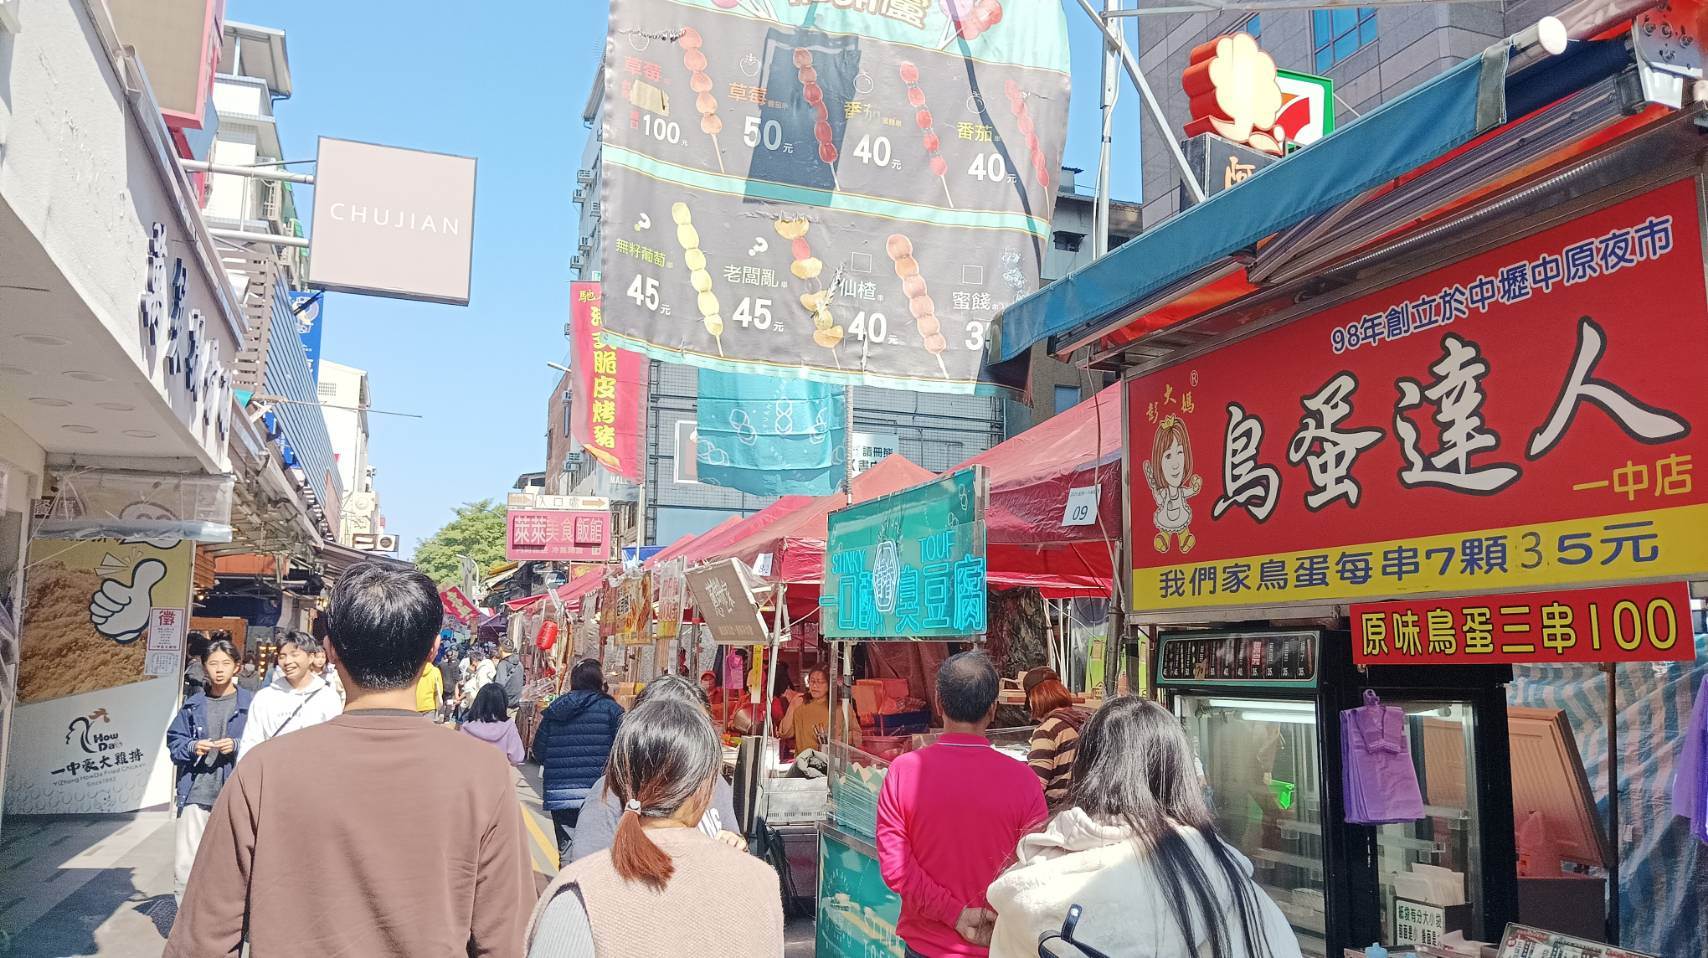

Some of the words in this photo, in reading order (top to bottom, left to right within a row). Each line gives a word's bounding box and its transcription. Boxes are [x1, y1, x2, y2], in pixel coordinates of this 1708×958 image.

[728, 81, 767, 106] 草莓
[956, 121, 993, 143] 番茄
[330, 202, 459, 236] CHUJIAN
[578, 289, 602, 303] 馳
[1331, 215, 1675, 355] 98年創立於中壢中原夜市
[1211, 316, 1692, 524] 鳥蛋達人
[1572, 453, 1693, 501] 一中店
[1361, 598, 1678, 656] 原味鳥蛋三串100
[93, 732, 119, 744] How
[51, 748, 144, 776] 一中豪大雞排
